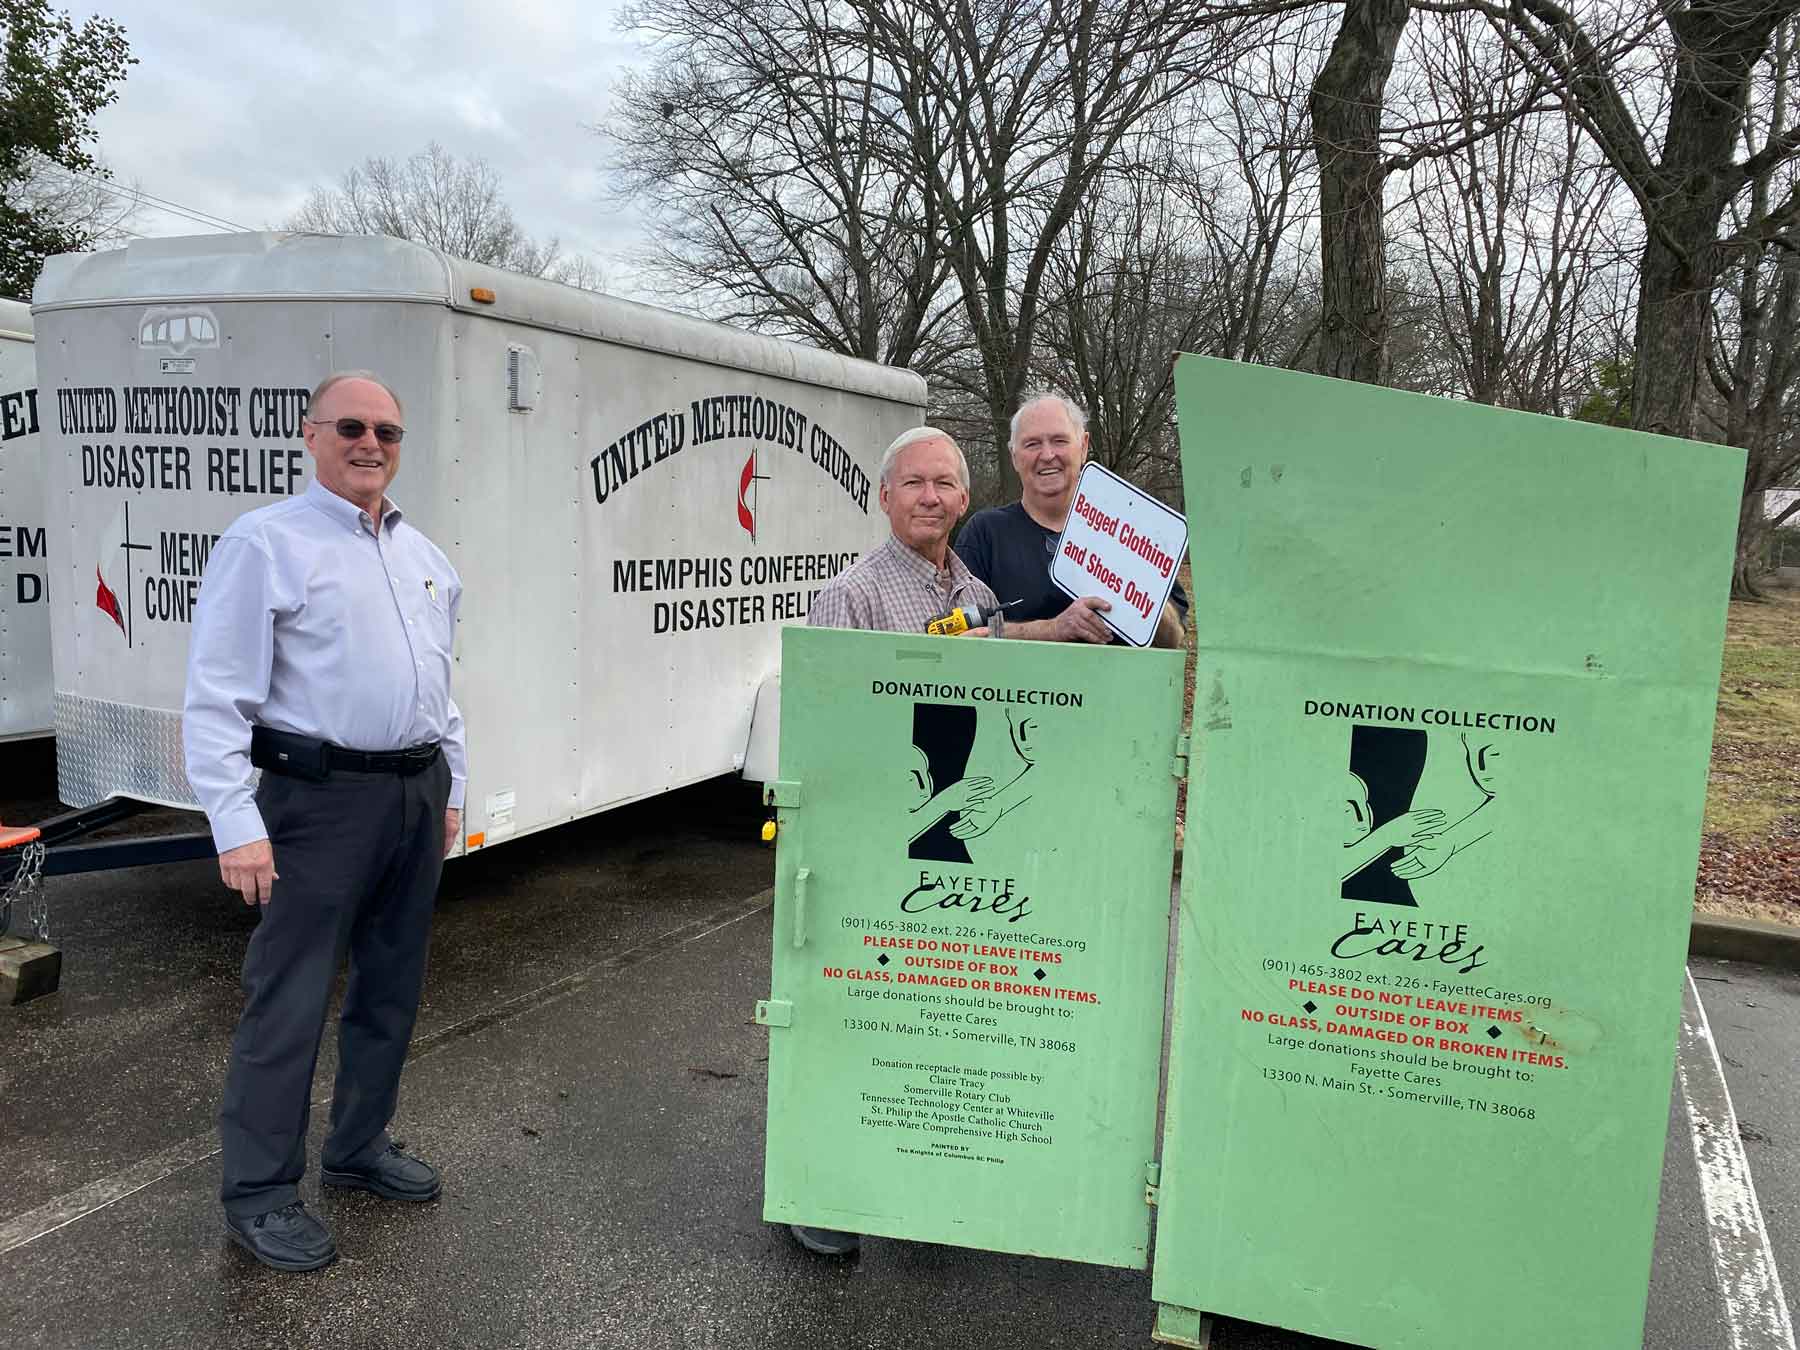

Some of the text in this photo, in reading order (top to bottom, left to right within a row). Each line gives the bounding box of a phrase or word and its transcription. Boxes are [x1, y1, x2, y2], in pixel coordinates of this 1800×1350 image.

[57, 387, 116, 435] UNITED
[124, 387, 240, 437] METHODIST
[82, 445, 302, 495] DISASTER RELIEF
[590, 395, 871, 515] UNITED METHODIST CHURCH
[1075, 493, 1174, 578] Bagged Clothing
[613, 557, 732, 592] MEMPHIS
[1064, 540, 1155, 619] and Shoes Only
[145, 576, 201, 623] CONF
[654, 595, 765, 634] DISASTER
[872, 680, 1083, 707] DONATION COLLECTION
[1304, 700, 1556, 733] DONATION COLLECTION
[920, 870, 1016, 895] FAYETTE
[900, 884, 1032, 922] Cares
[841, 916, 1086, 952] (901) 465-3802 ext. 226 FayetteCares.org
[1355, 912, 1468, 943] FAYETTE
[864, 936, 1062, 964] PLEASE DO NOT LEAVE ITEMS
[905, 956, 1018, 976] OUTSIDE OF BOX
[1331, 927, 1488, 974] Cares
[823, 967, 1102, 1005] NO GLASS, DAMAGED OR BROKEN ITEMS.
[1262, 959, 1551, 1008] (901) 465-3802 ext. 226 FayetteCares.org
[847, 986, 1074, 1018] Large donations should be brought to:
[920, 1008, 998, 1026] Fayette Cares
[1289, 980, 1522, 1023] PLEASE DO NOT LEAVE ITEMS
[843, 1018, 1076, 1052] 13300 N. Main St. Somerville, TN 38068
[1336, 1004, 1468, 1034] OUTSIDE OF BOX
[1242, 1010, 1568, 1070] NO GLASS, DAMAGED OR BROKEN ITEMS.
[872, 1058, 912, 1070] Donation
[916, 1063, 960, 1076] receptacle
[964, 1067, 988, 1077] made
[991, 1070, 1028, 1081] possible
[1268, 1034, 1534, 1082] Large donations should be brought to:
[1350, 1063, 1441, 1087] Fayette Cares
[904, 1084, 1010, 1103] Somerville Rotary Club
[930, 1075, 984, 1090] Claire Tracy
[1262, 1068, 1536, 1120] 13300 N. Main St. Somerville, TN 38068
[860, 1092, 1054, 1120] Tennessee Technology Center at Whiteville
[872, 1106, 1042, 1132] St. Philip the Apostle Catholic Church
[861, 1116, 1052, 1144] Fayette-Ware Comprehensive High School
